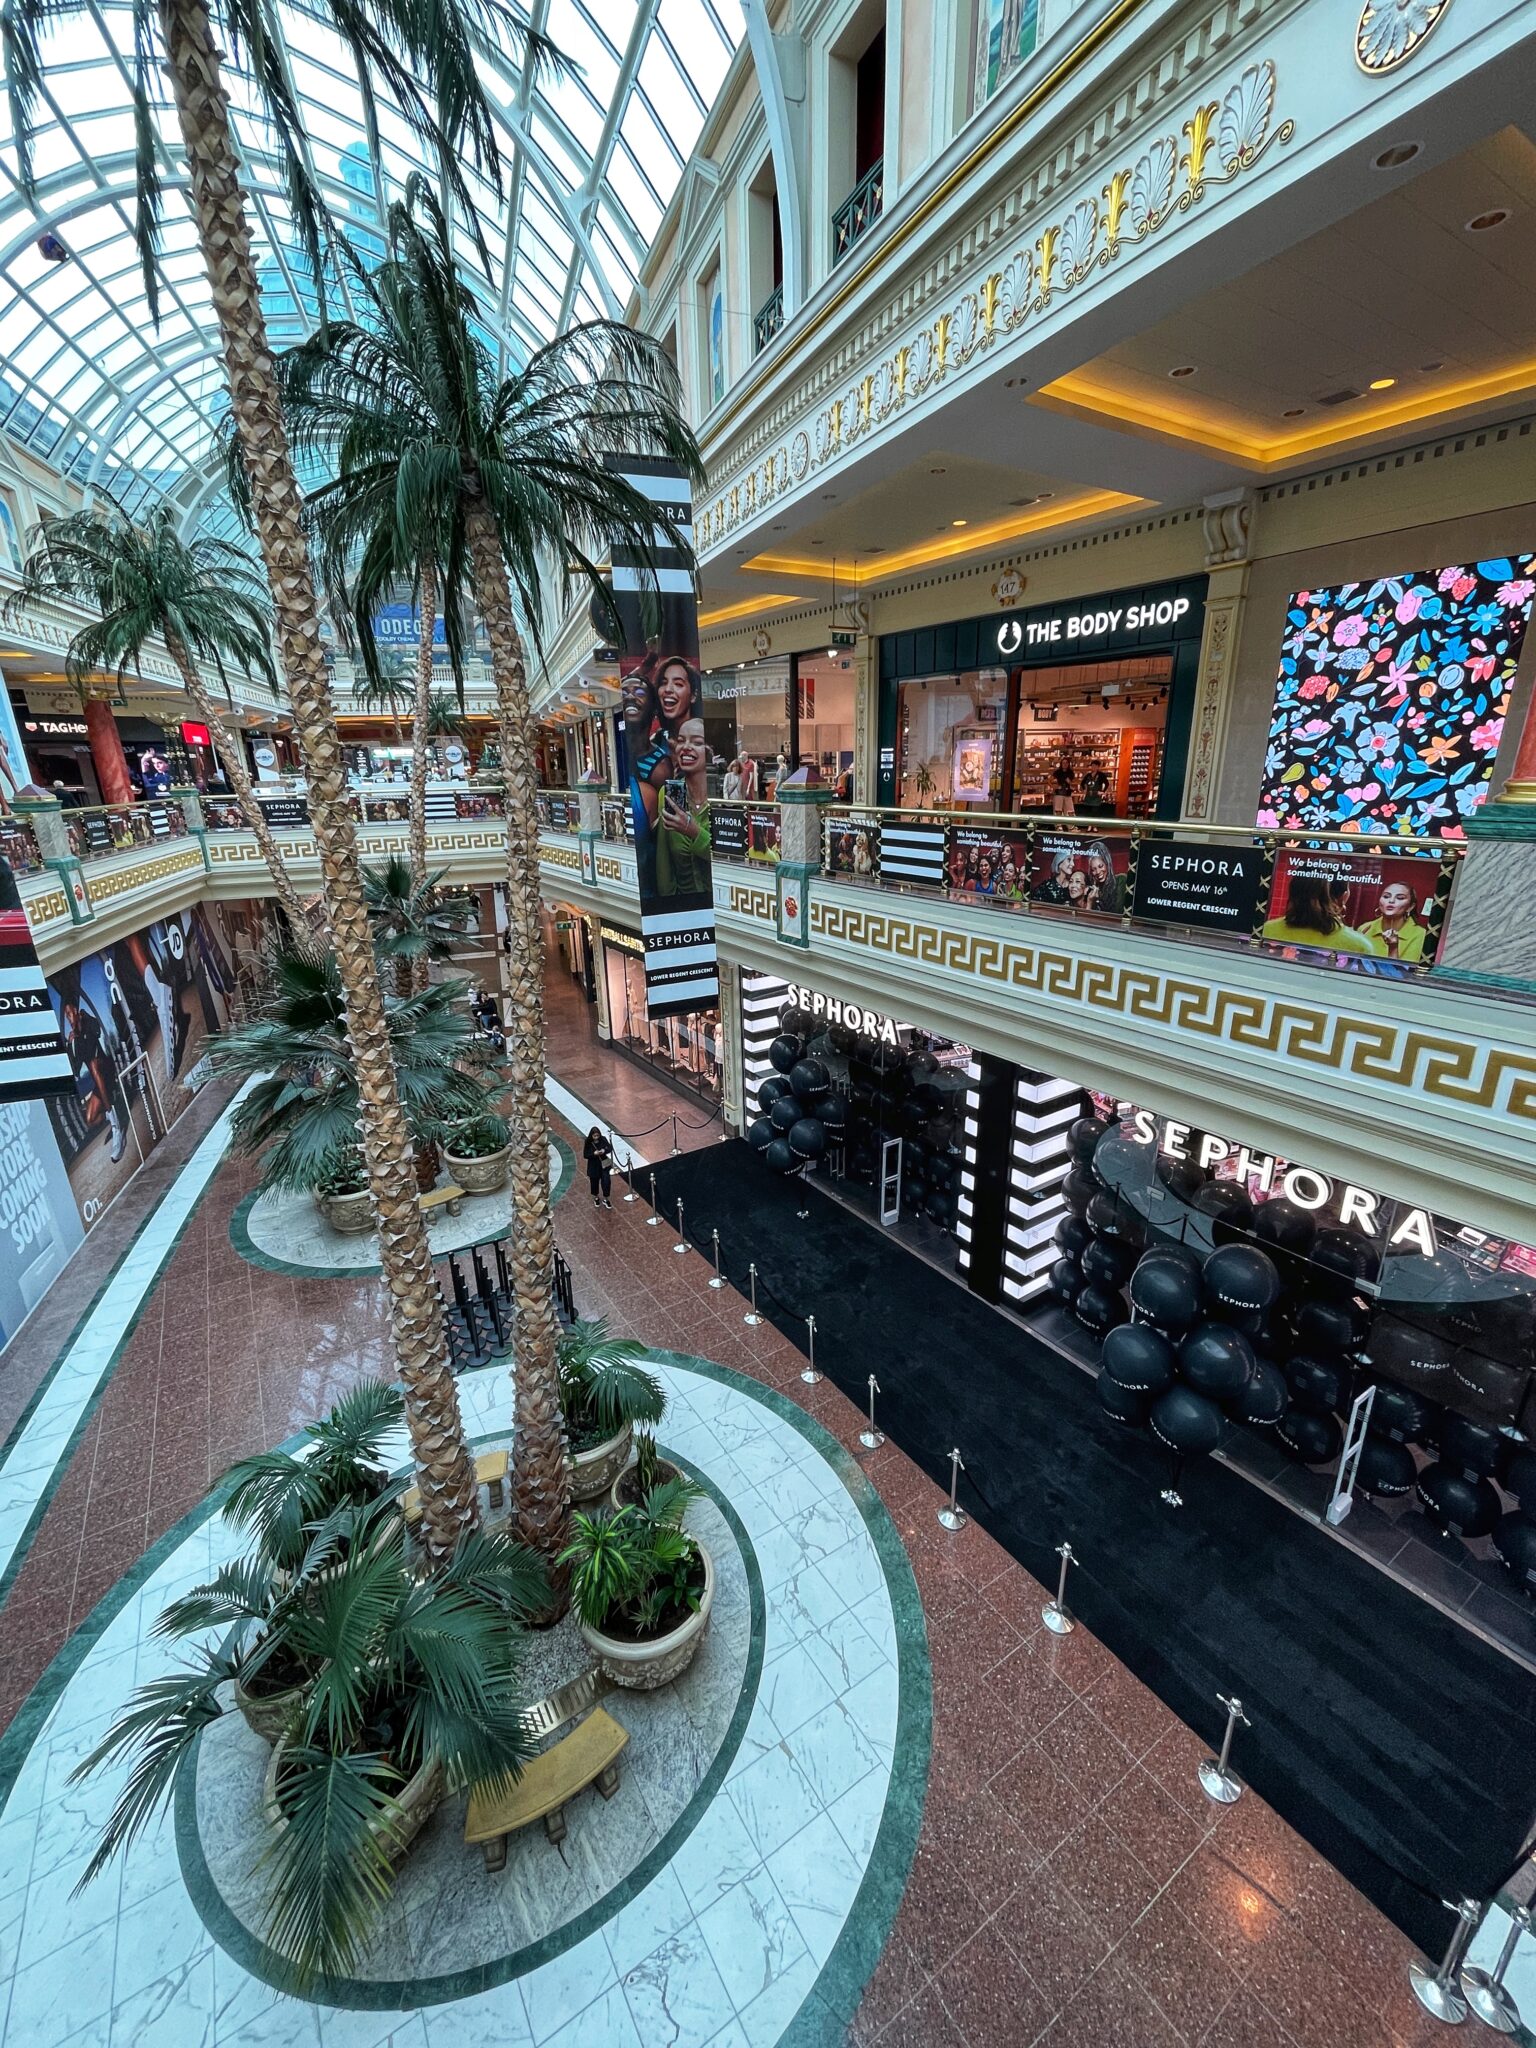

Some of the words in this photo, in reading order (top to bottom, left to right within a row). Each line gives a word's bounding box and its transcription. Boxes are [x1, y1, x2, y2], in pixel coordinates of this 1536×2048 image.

[1000, 582, 1016, 595] 147
[381, 619, 423, 635] ODEO
[1026, 619, 1062, 645] THE
[1066, 608, 1123, 639] BODY
[1125, 598, 1190, 629] SHOP
[718, 686, 747, 700] LACOSTE
[714, 817, 742, 827] SEPHORA
[957, 839, 981, 847] something
[965, 831, 982, 840] belong
[1054, 837, 1074, 847] belong
[1042, 846, 1072, 855] something
[1151, 855, 1244, 877] SEPHORA
[1288, 857, 1305, 867] We
[1306, 858, 1340, 872] belong
[1341, 861, 1352, 871] to
[1287, 869, 1334, 882] something
[1336, 871, 1383, 885] beautiful.
[1161, 880, 1189, 891] OPENS
[1191, 883, 1210, 894] MAY
[1147, 897, 1172, 908] LOWER
[1172, 900, 1201, 911] REGENT
[1201, 904, 1239, 916] CRESCENT
[649, 931, 710, 948] SEPHORA
[650, 973, 669, 981] LOWER
[689, 967, 714, 976] CRESCENT
[787, 983, 899, 1046] SEPHORA
[16, 1041, 58, 1051] CRESCENT
[1132, 1110, 1437, 1258] SEPHORA
[11, 1193, 51, 1255] SOON
[1218, 1293, 1261, 1309] SEPHORA
